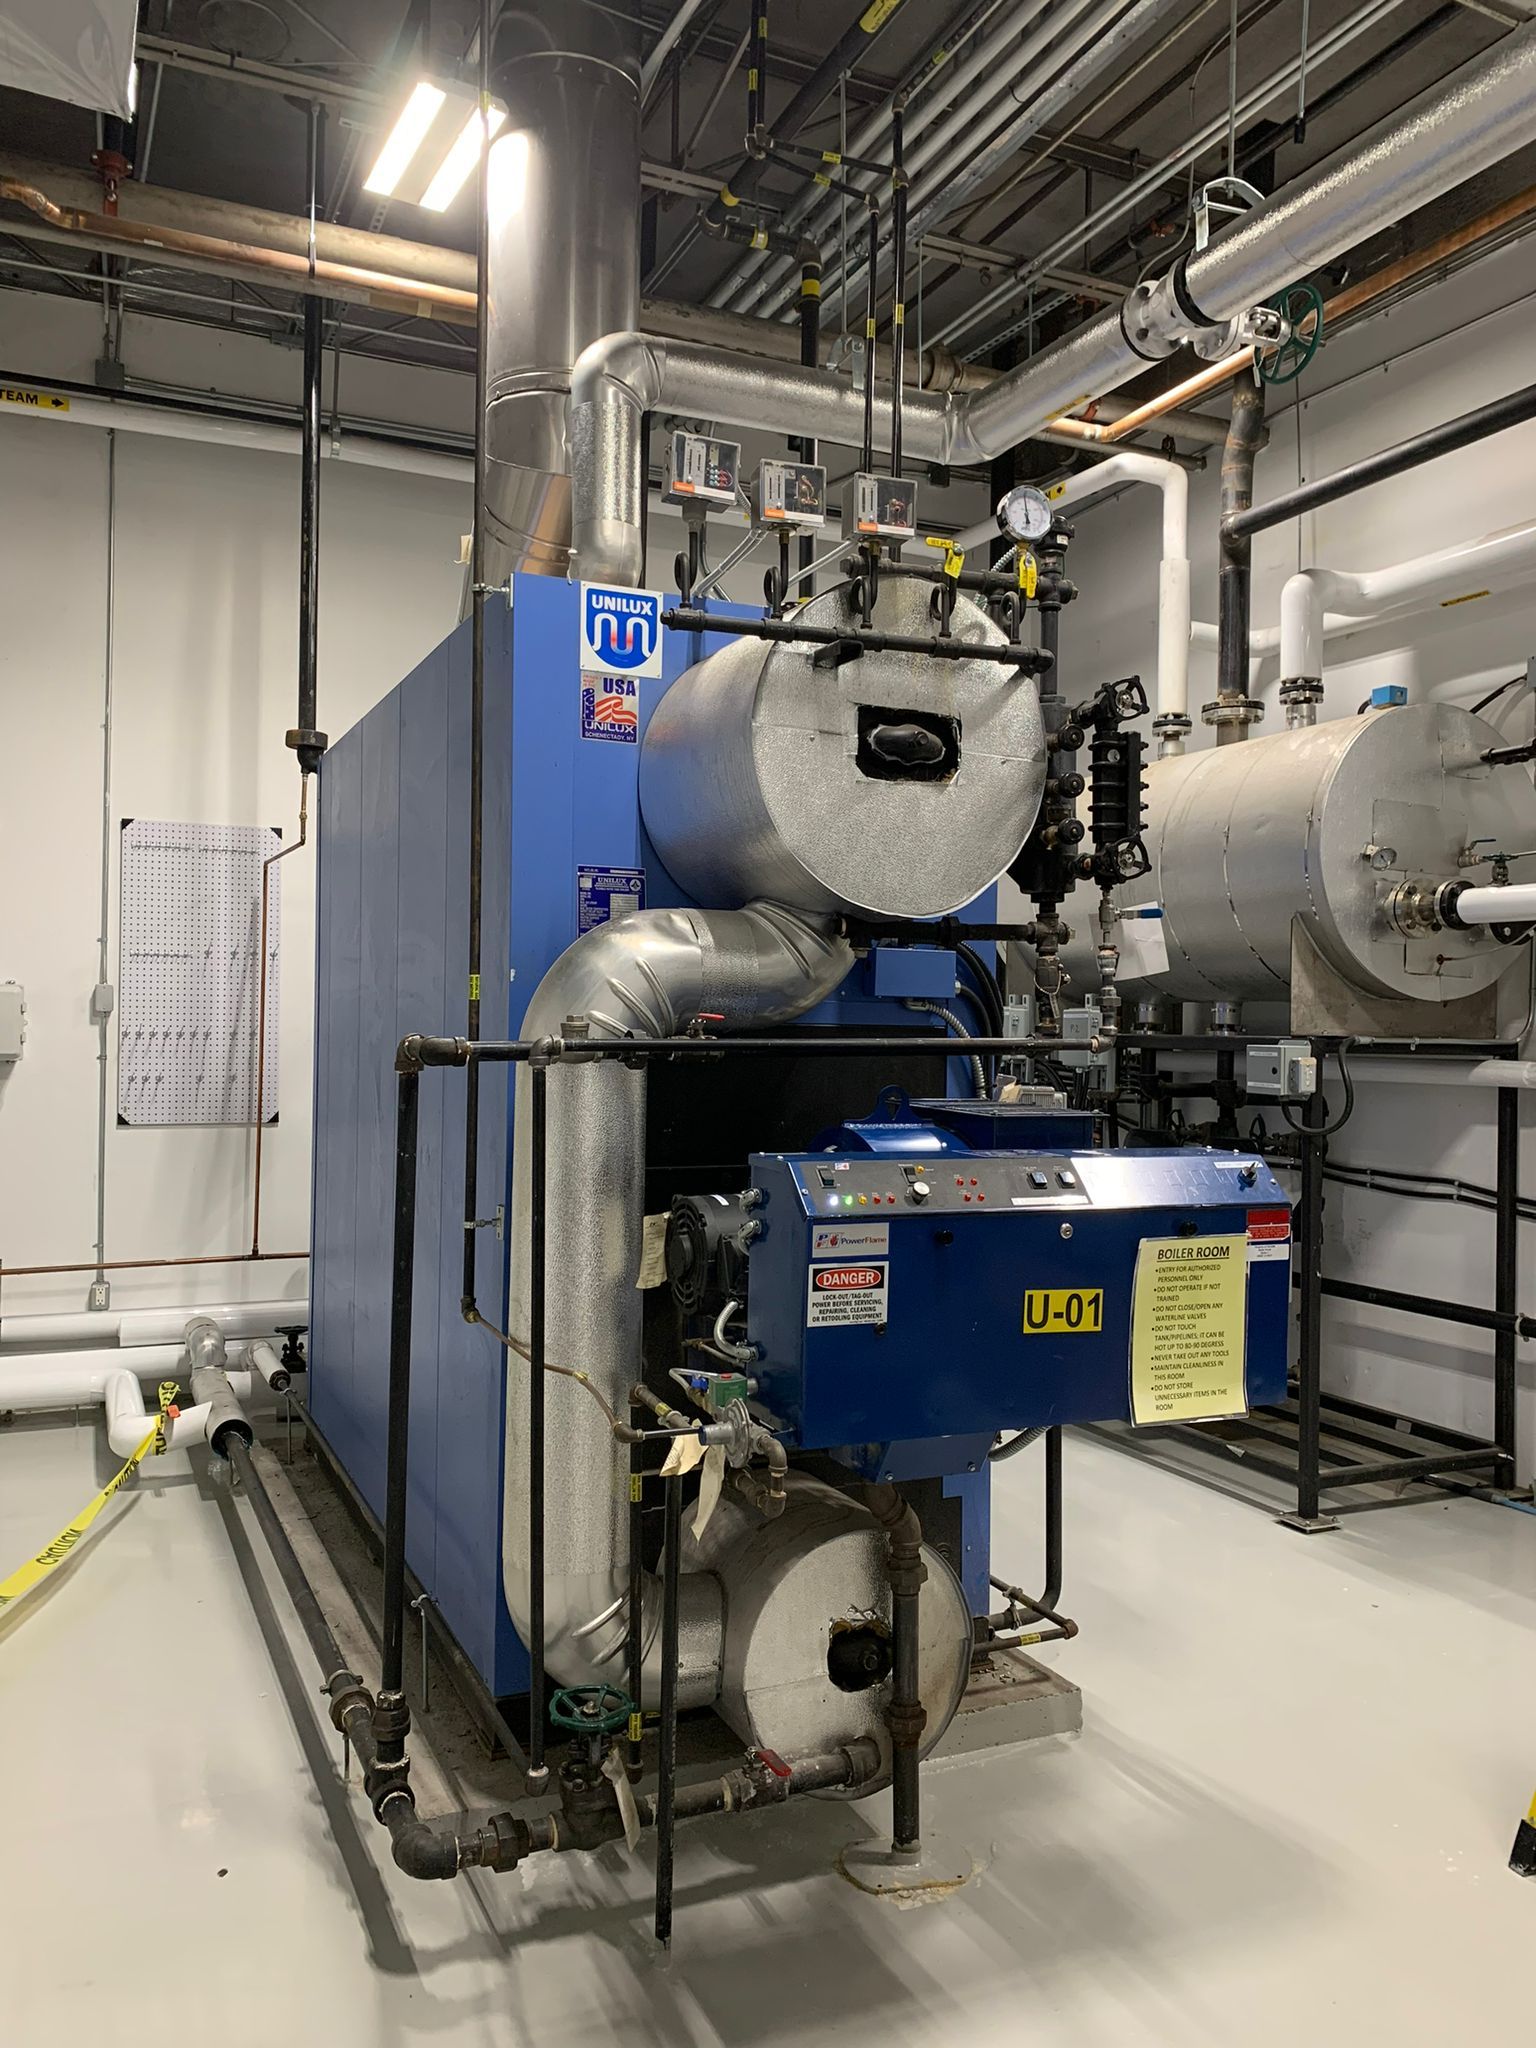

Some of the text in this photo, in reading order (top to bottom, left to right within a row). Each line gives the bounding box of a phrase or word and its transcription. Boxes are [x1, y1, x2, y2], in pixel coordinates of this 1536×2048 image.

[591, 594, 653, 616] UNILUX
[603, 677, 636, 696] USA
[584, 720, 634, 734] UNILUX
[1157, 1246, 1230, 1259] BOILER ROOM
[1187, 1264, 1221, 1272] AUTHORIZED
[823, 1272, 875, 1286] DANGER
[1178, 1284, 1203, 1292] OPERATE
[854, 1299, 884, 1307] SERVICING,
[1177, 1303, 1211, 1312] CLOSE/OPEN
[1027, 1293, 1100, 1329] U-01
[821, 1314, 851, 1322] RETOOLING
[852, 1312, 883, 1320] EQUIPMENT
[1155, 1313, 1186, 1322] WATERLINE
[1201, 1340, 1225, 1348] DEGRESS
[1154, 1363, 1182, 1371] MAINTAIN
[1182, 1361, 1217, 1370] CLEANLINESS
[1154, 1392, 1193, 1401] UNNECESSARY
